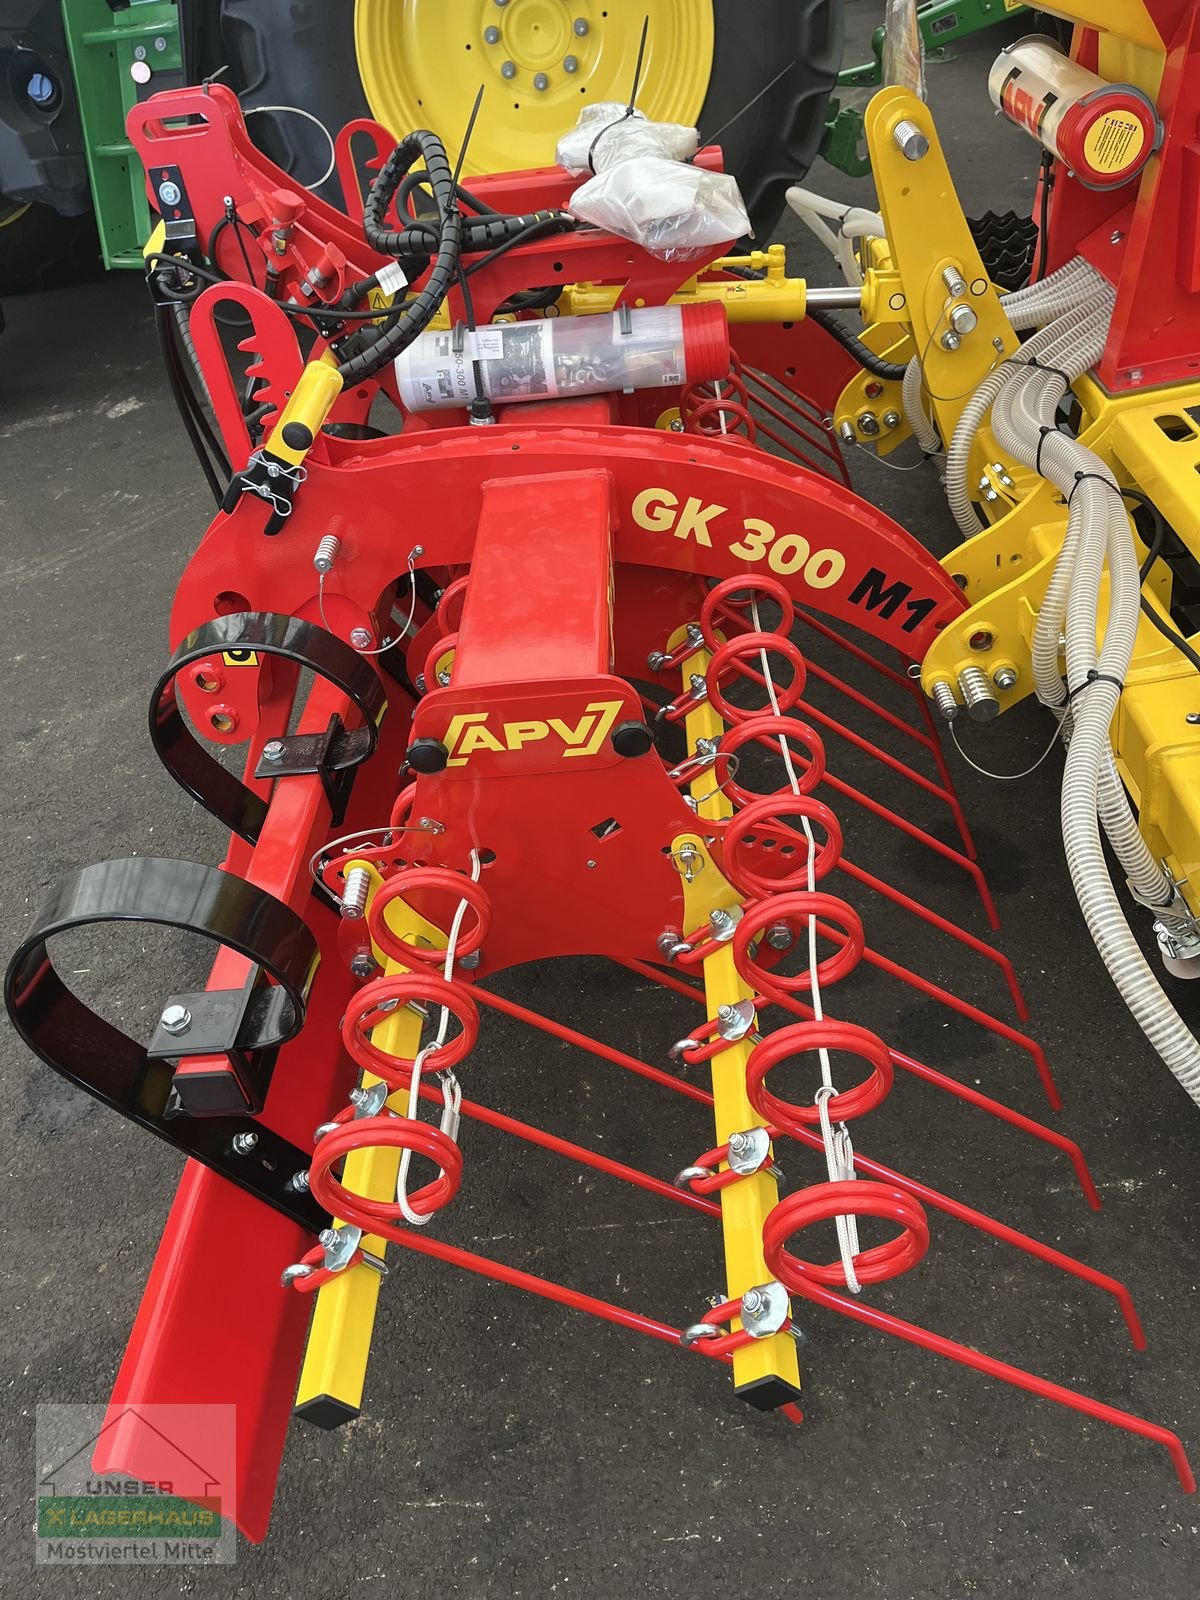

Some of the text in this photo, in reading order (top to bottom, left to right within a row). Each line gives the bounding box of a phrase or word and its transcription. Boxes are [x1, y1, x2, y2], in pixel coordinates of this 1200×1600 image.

[454, 352, 466, 387] 50-300
[631, 487, 939, 634] GK 300 M1
